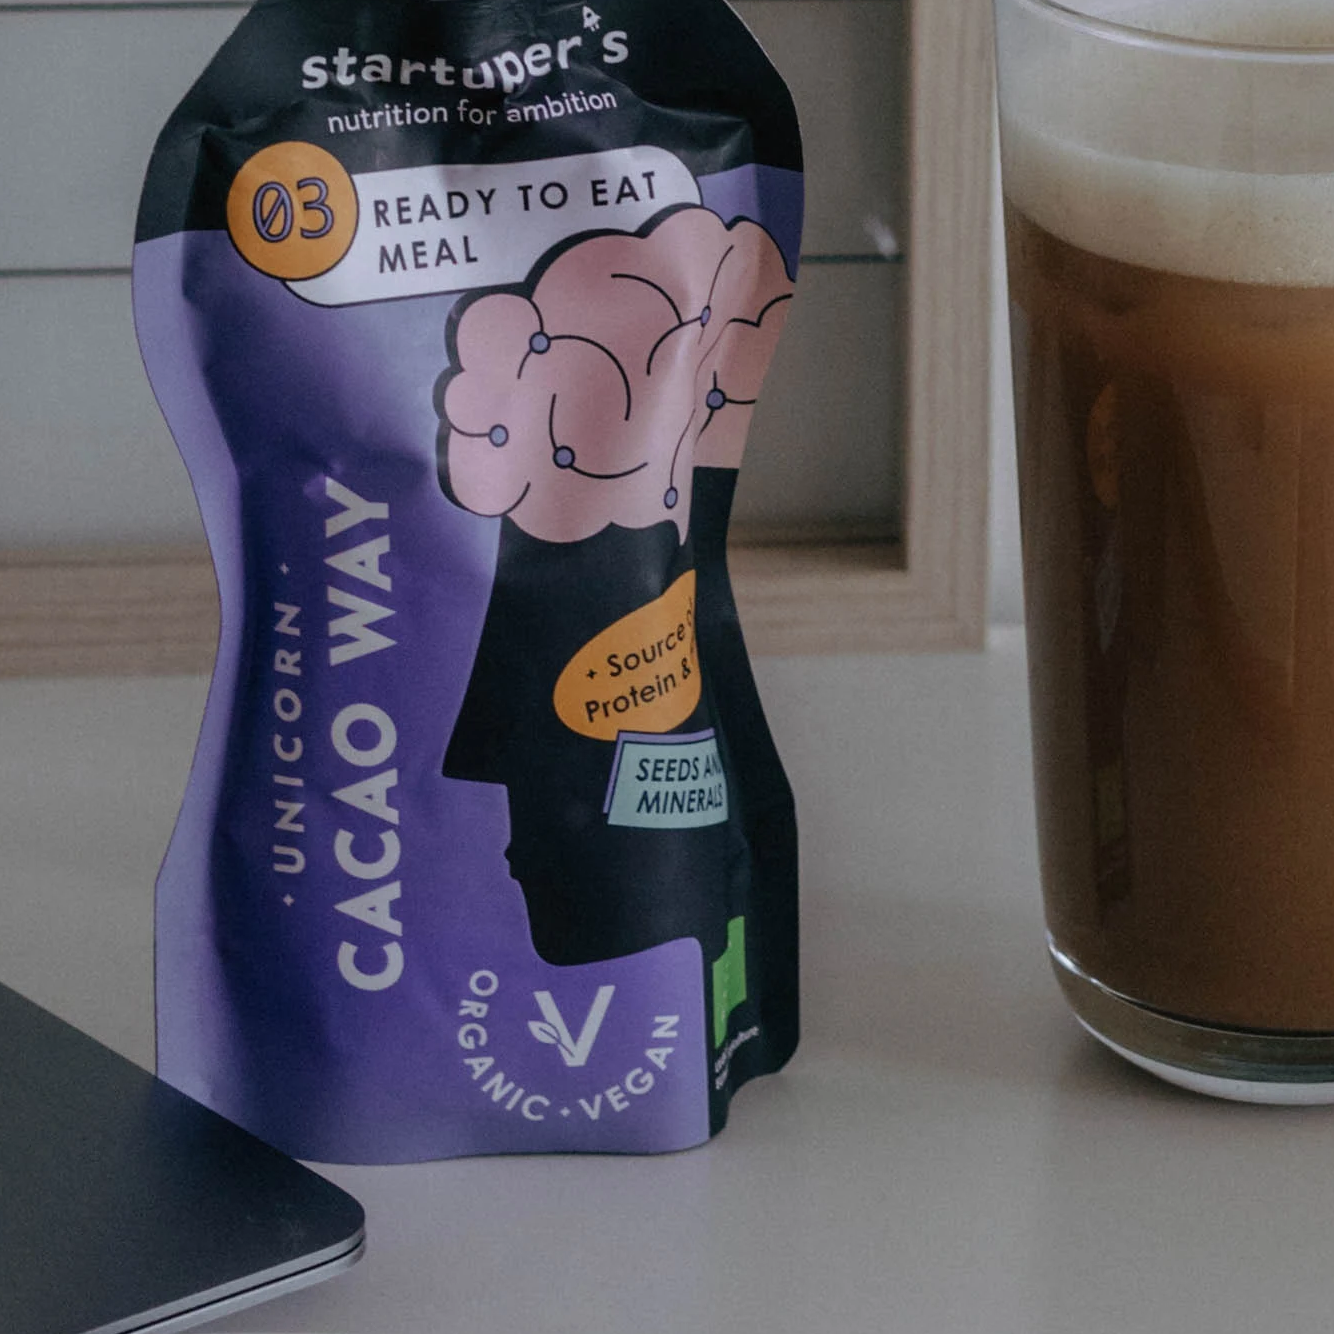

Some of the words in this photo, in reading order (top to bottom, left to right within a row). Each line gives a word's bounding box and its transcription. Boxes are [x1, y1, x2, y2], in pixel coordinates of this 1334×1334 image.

[327, 101, 448, 134] nutrition
[457, 97, 497, 126] for
[505, 89, 618, 123] ambition
[252, 177, 335, 243] 03
[374, 187, 497, 227] READY
[517, 182, 567, 212] TO
[591, 171, 657, 207] EAT
[378, 235, 478, 274] MEAL
[324, 475, 398, 667] WAY
[607, 622, 686, 677] Source
[584, 673, 677, 723] Protein
[681, 657, 691, 680] &
[273, 601, 305, 875] UNICORN
[635, 755, 700, 782] SEEDS
[636, 782, 724, 814] MINERALS
[331, 702, 405, 992] CACAO
[457, 969, 551, 1121] ORGANIC
[578, 1014, 680, 1120] VEGAN
